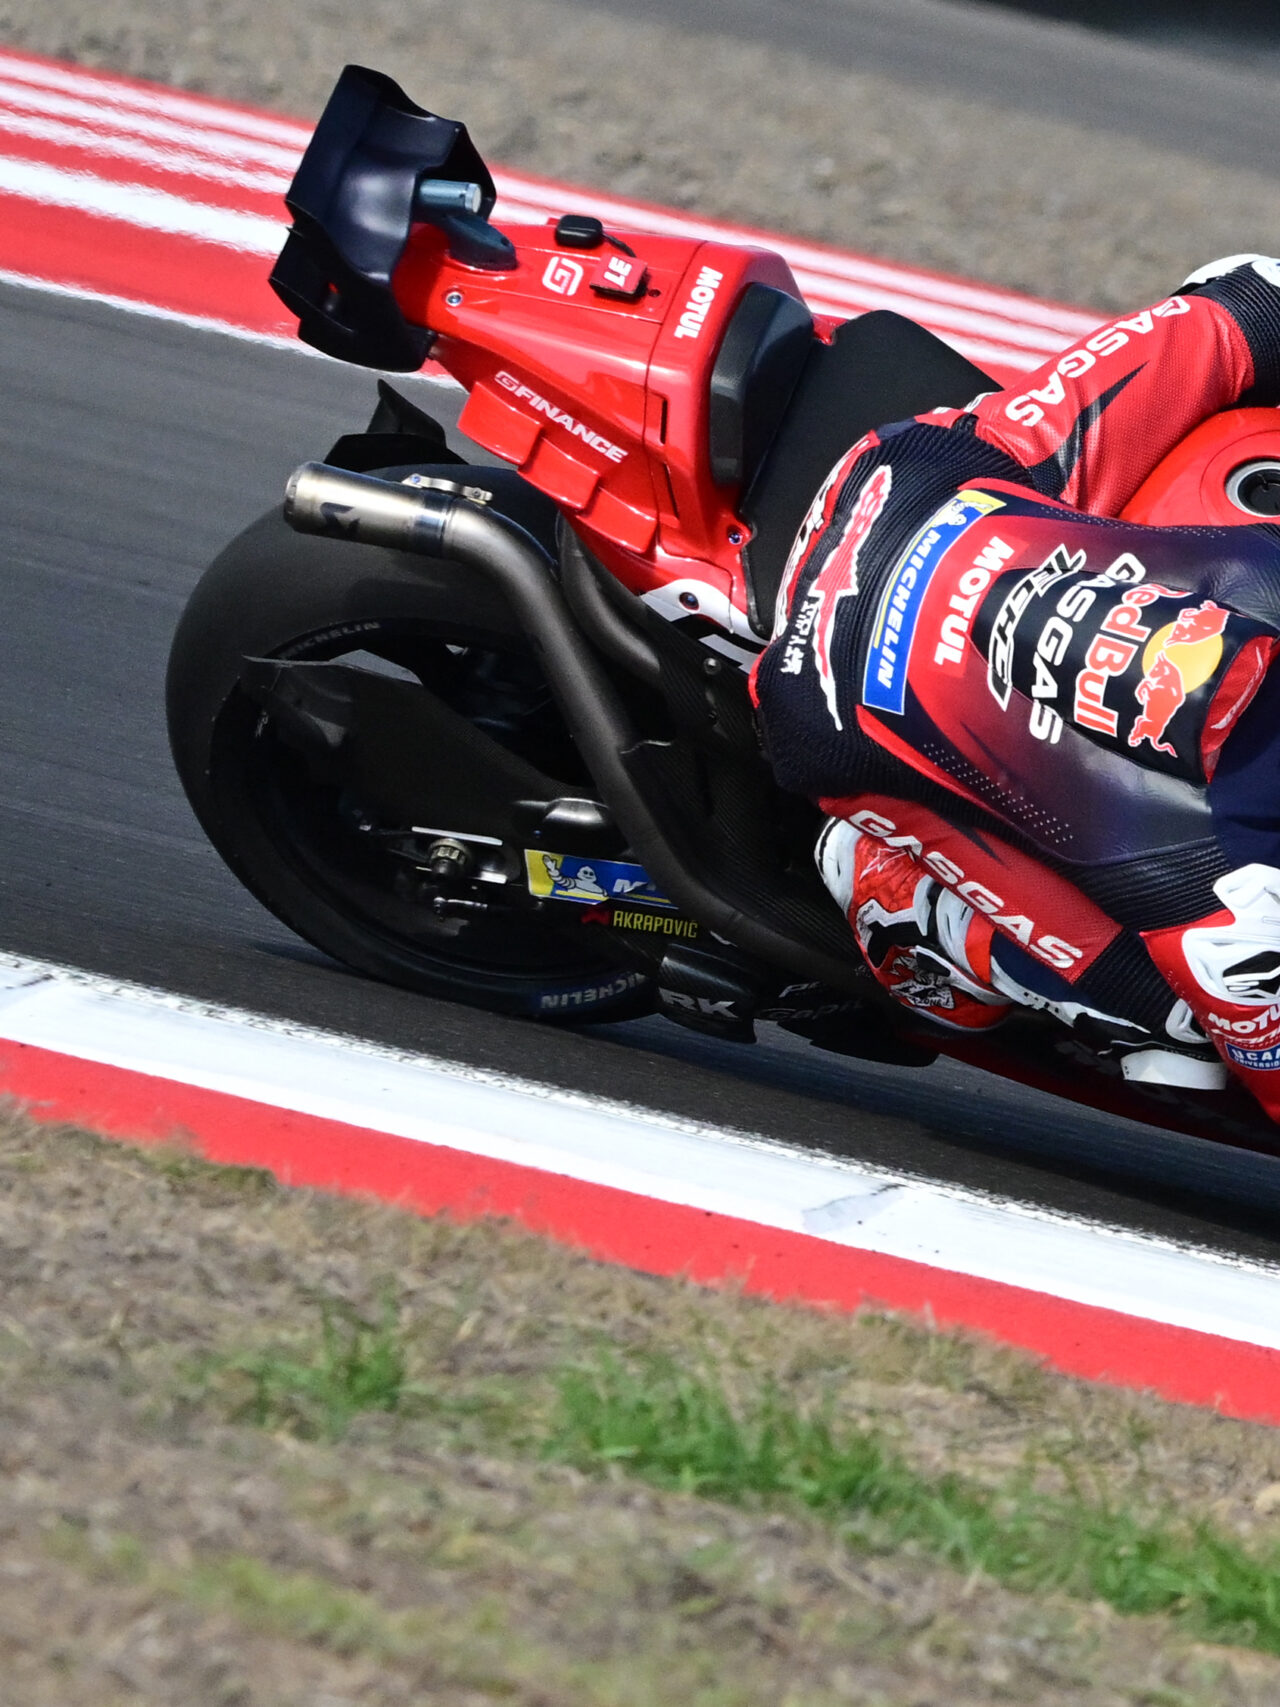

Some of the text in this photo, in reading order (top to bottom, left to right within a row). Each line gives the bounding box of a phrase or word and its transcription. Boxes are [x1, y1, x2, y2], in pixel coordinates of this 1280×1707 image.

[673, 266, 724, 339] MOTUL
[1004, 295, 1191, 427] GASGAS
[876, 524, 942, 690] MICHELIN
[933, 535, 1015, 667] MOTUL
[1029, 552, 1146, 745] GASGAS
[848, 809, 1084, 972] GASGAS
[658, 986, 741, 1019] RK
